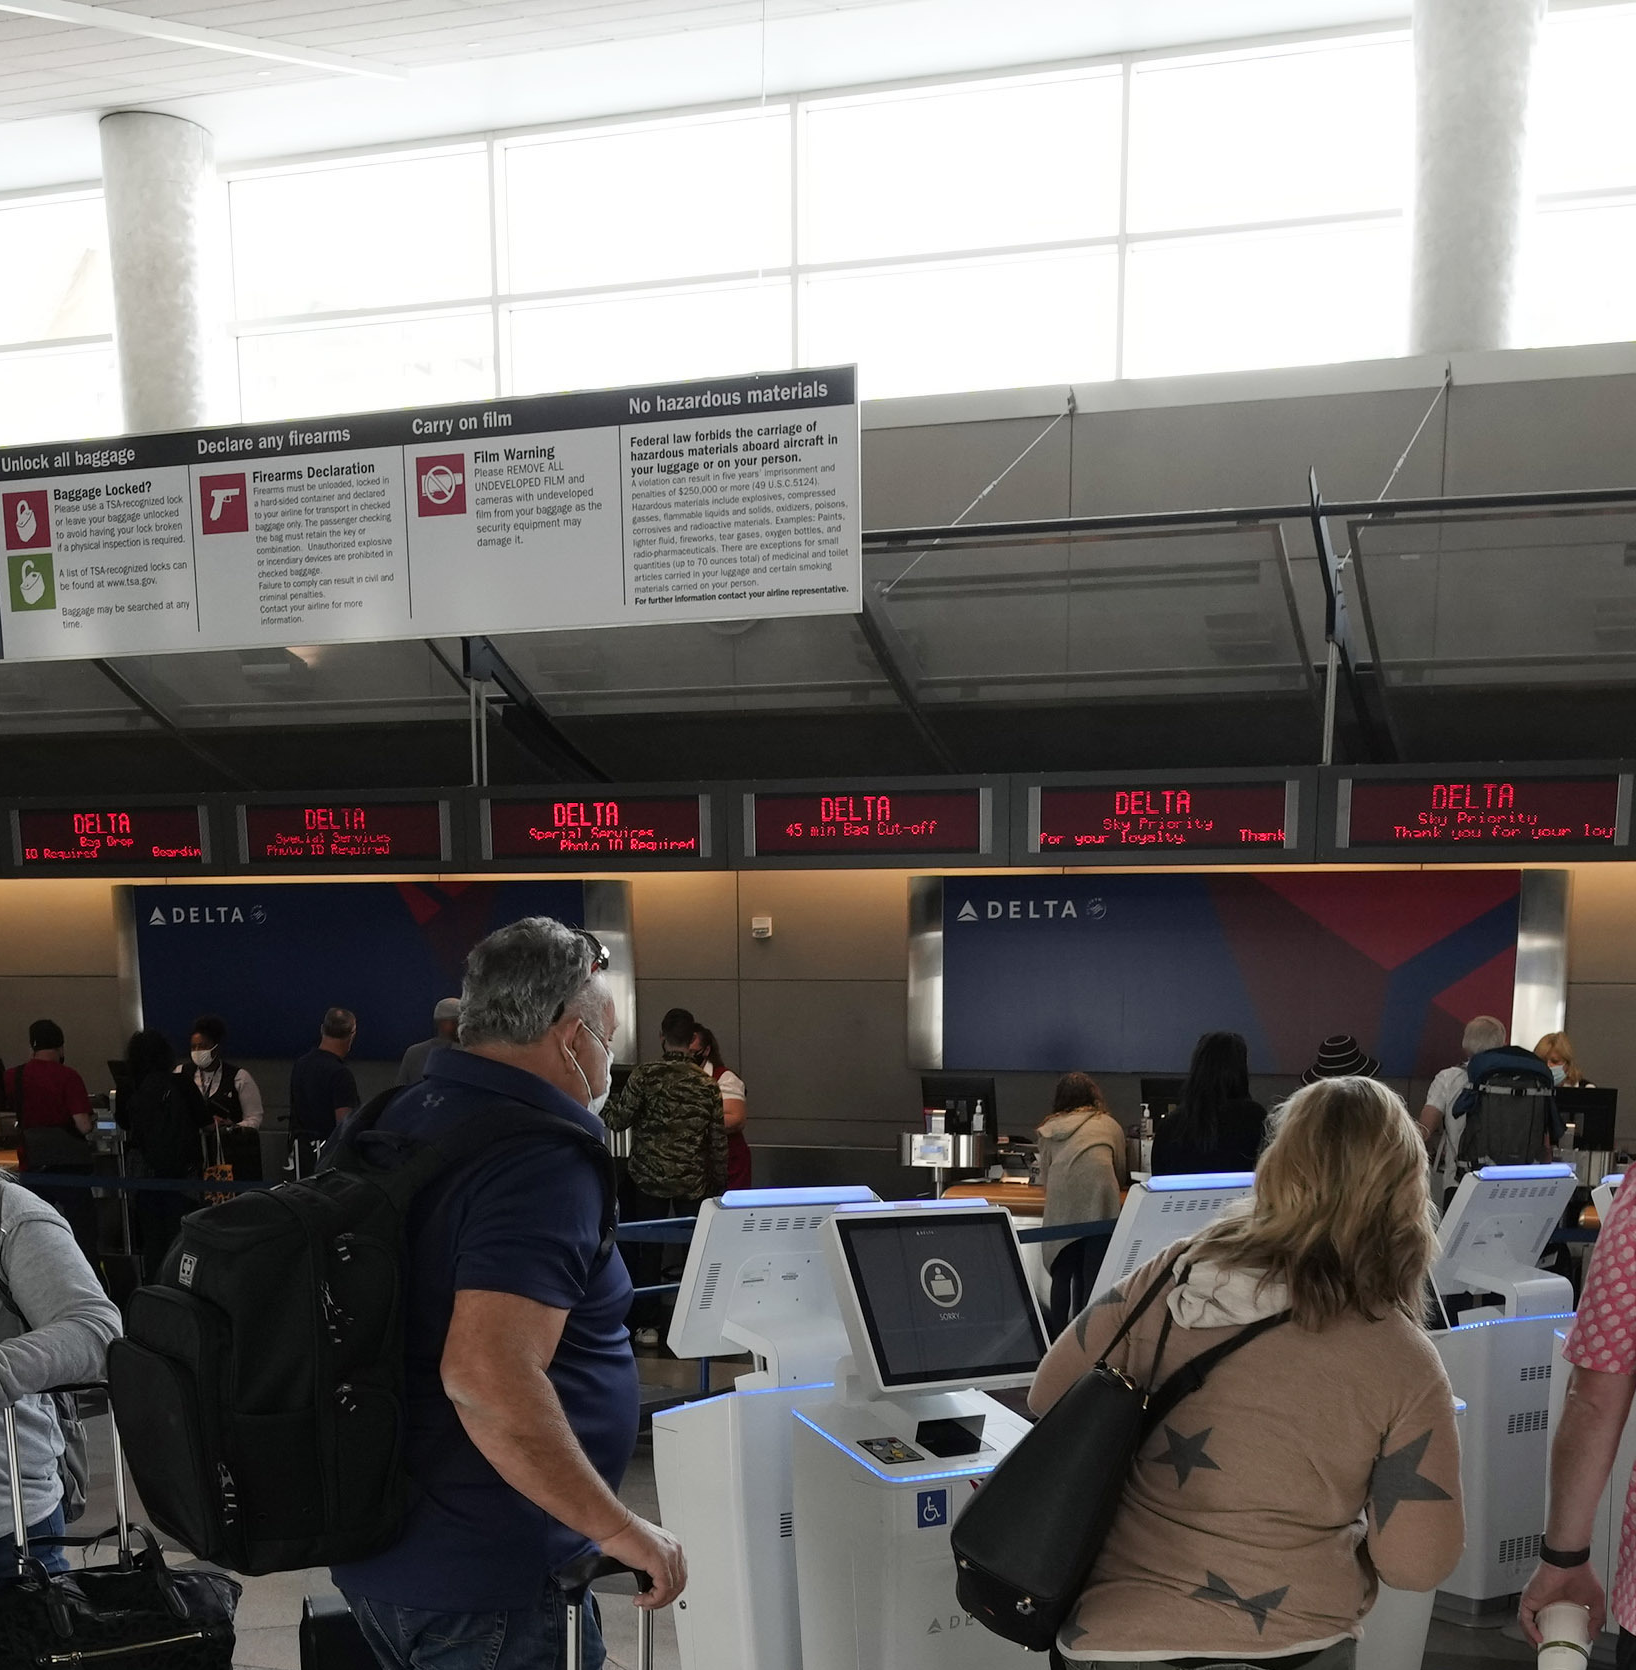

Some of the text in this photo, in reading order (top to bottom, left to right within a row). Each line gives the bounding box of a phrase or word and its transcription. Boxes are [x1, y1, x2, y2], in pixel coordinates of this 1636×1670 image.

[629, 380, 828, 415] No hazardous materials
[412, 411, 512, 436] Carry on film
[630, 420, 817, 448] Federal law forbids the carriage of
[197, 428, 351, 455] Declare any firearms
[630, 434, 838, 461] hazardous materials aboard aircraft in
[1, 448, 135, 472] Unlock all baggage
[474, 445, 555, 464] Film Warning
[252, 462, 375, 484] Firearms Declaration
[474, 461, 564, 478] Please REMOVE ALL
[631, 454, 802, 478] your luggage or on your person.
[53, 480, 152, 502] Baggage Locked?
[474, 474, 585, 492] UNDEVELOPED FILM and
[475, 487, 594, 506] cameras with undeveloped
[475, 501, 603, 519] film from your baggage as the
[476, 518, 582, 534] security equipment may
[476, 535, 524, 548] damage it.
[634, 585, 849, 605] For further information contact your airline representative.
[1115, 790, 1191, 815] DELTA
[1432, 783, 1515, 809] DELTA
[305, 808, 365, 830] DELTA
[553, 802, 619, 827] DELTA
[821, 795, 891, 822] DELTA
[1418, 811, 1538, 827] Sky Priority
[73, 812, 131, 834] DELTA
[786, 820, 937, 837] 45 min Bag Cut-off
[1103, 817, 1214, 833] Sky Priority
[172, 907, 244, 923] DELTA
[987, 900, 1077, 919] DELTA
